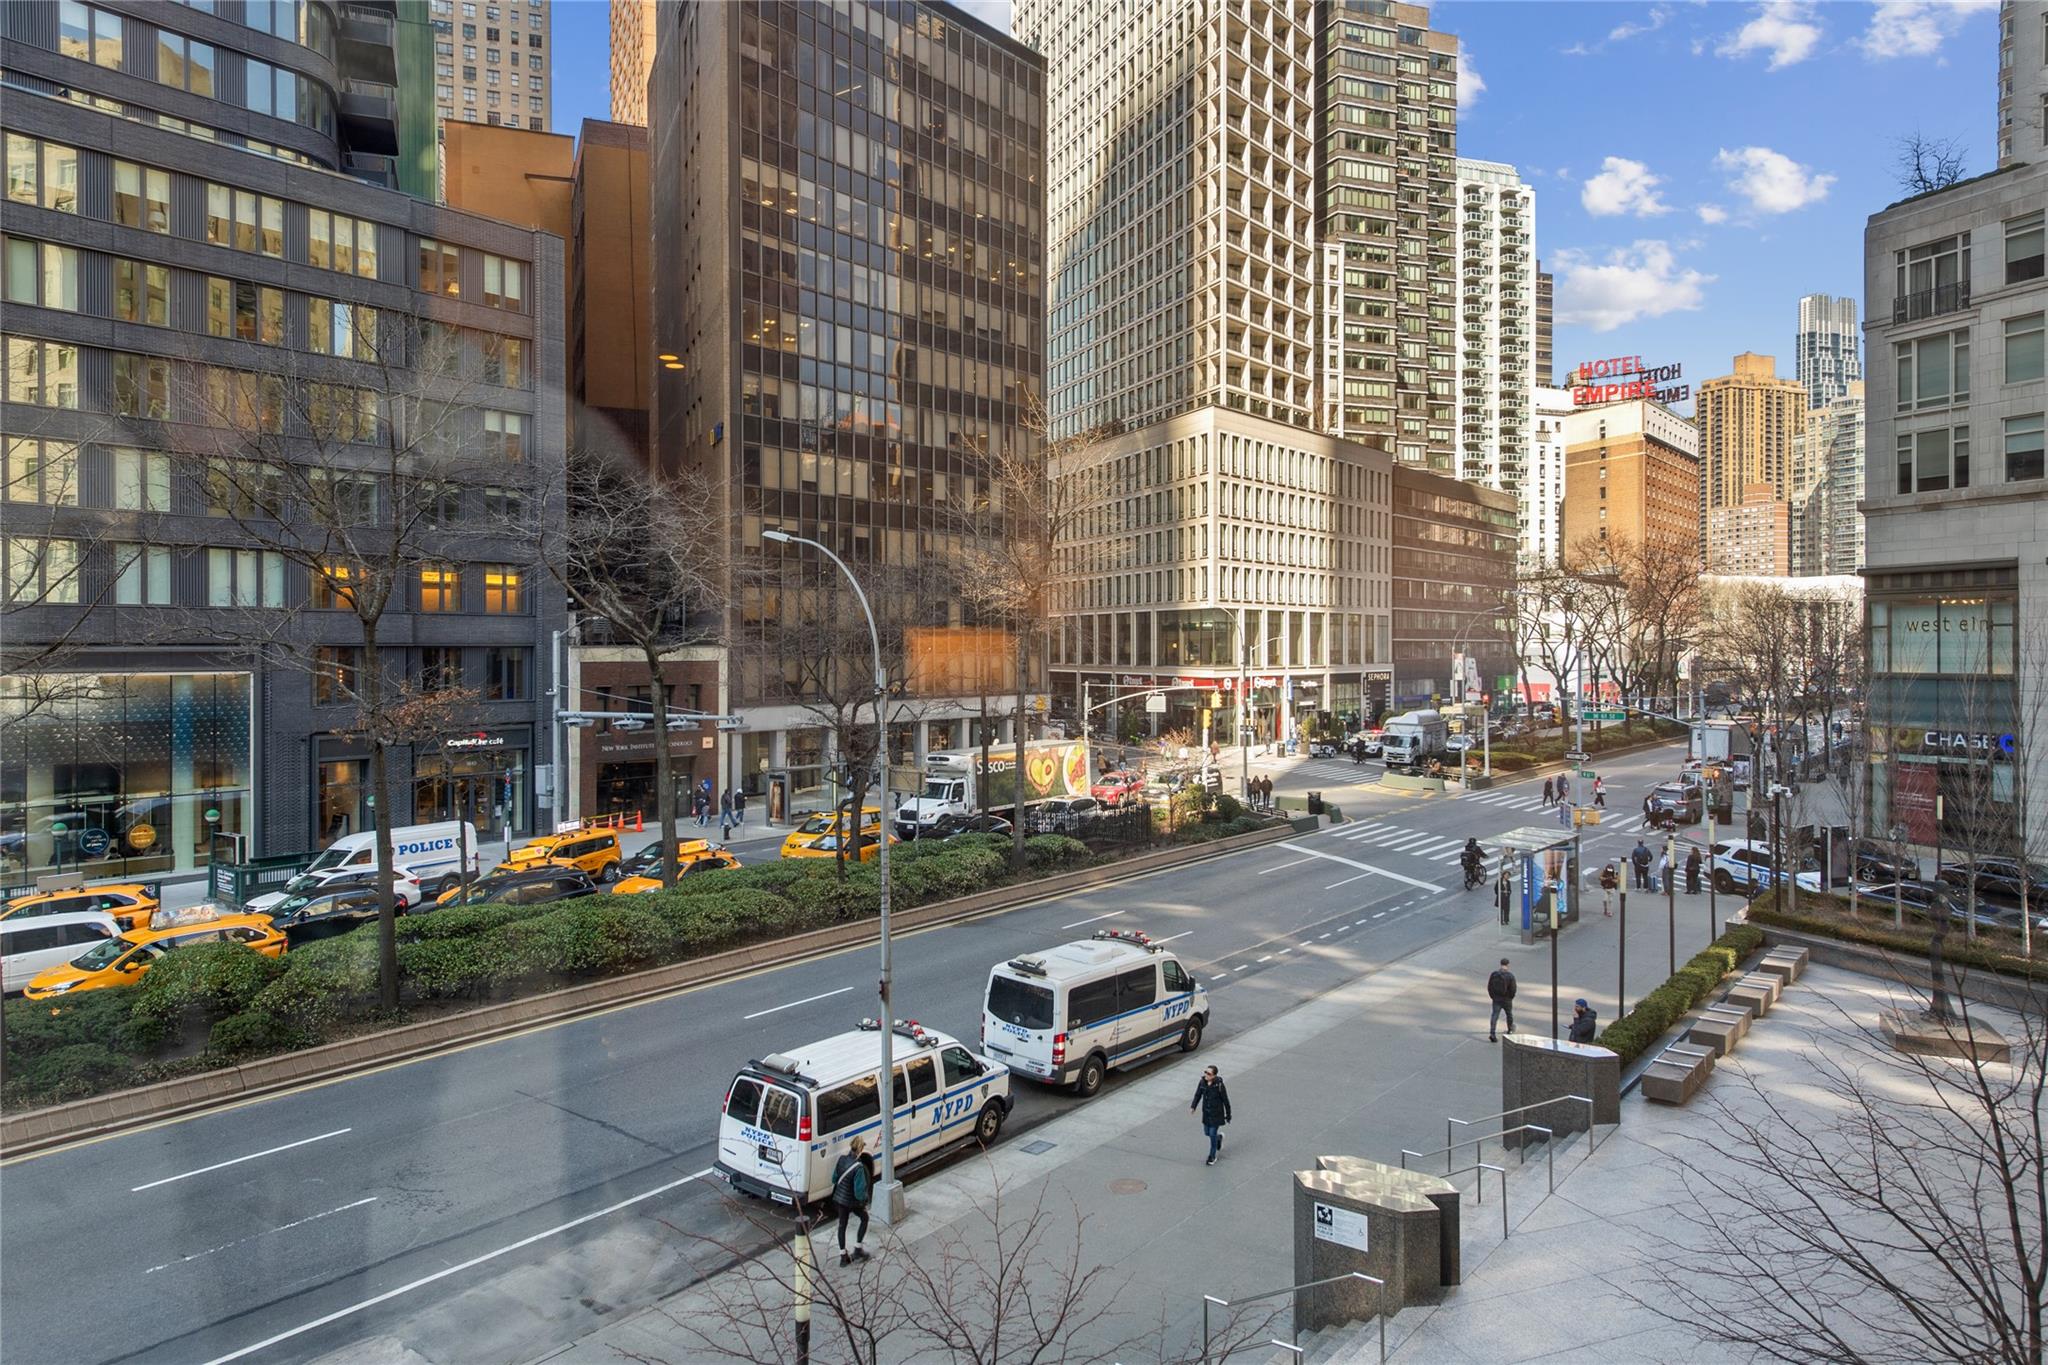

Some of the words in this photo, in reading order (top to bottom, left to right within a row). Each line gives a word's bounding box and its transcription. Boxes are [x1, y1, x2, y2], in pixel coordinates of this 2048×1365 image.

[1580, 356, 1645, 380] HOTEL
[1573, 381, 1657, 405] EMPIRE
[1907, 616, 1950, 632] west
[1924, 731, 1996, 750] CHASE
[976, 759, 1005, 775] Ssco
[398, 838, 453, 855] POLICE
[1163, 1000, 1190, 1021] NYPD
[1002, 1026, 1031, 1039] POLICE
[1005, 1023, 1029, 1034] NYPD
[931, 1093, 973, 1127] NYPD
[740, 1130, 774, 1147] POLICE
[743, 1126, 771, 1140] NYPD
